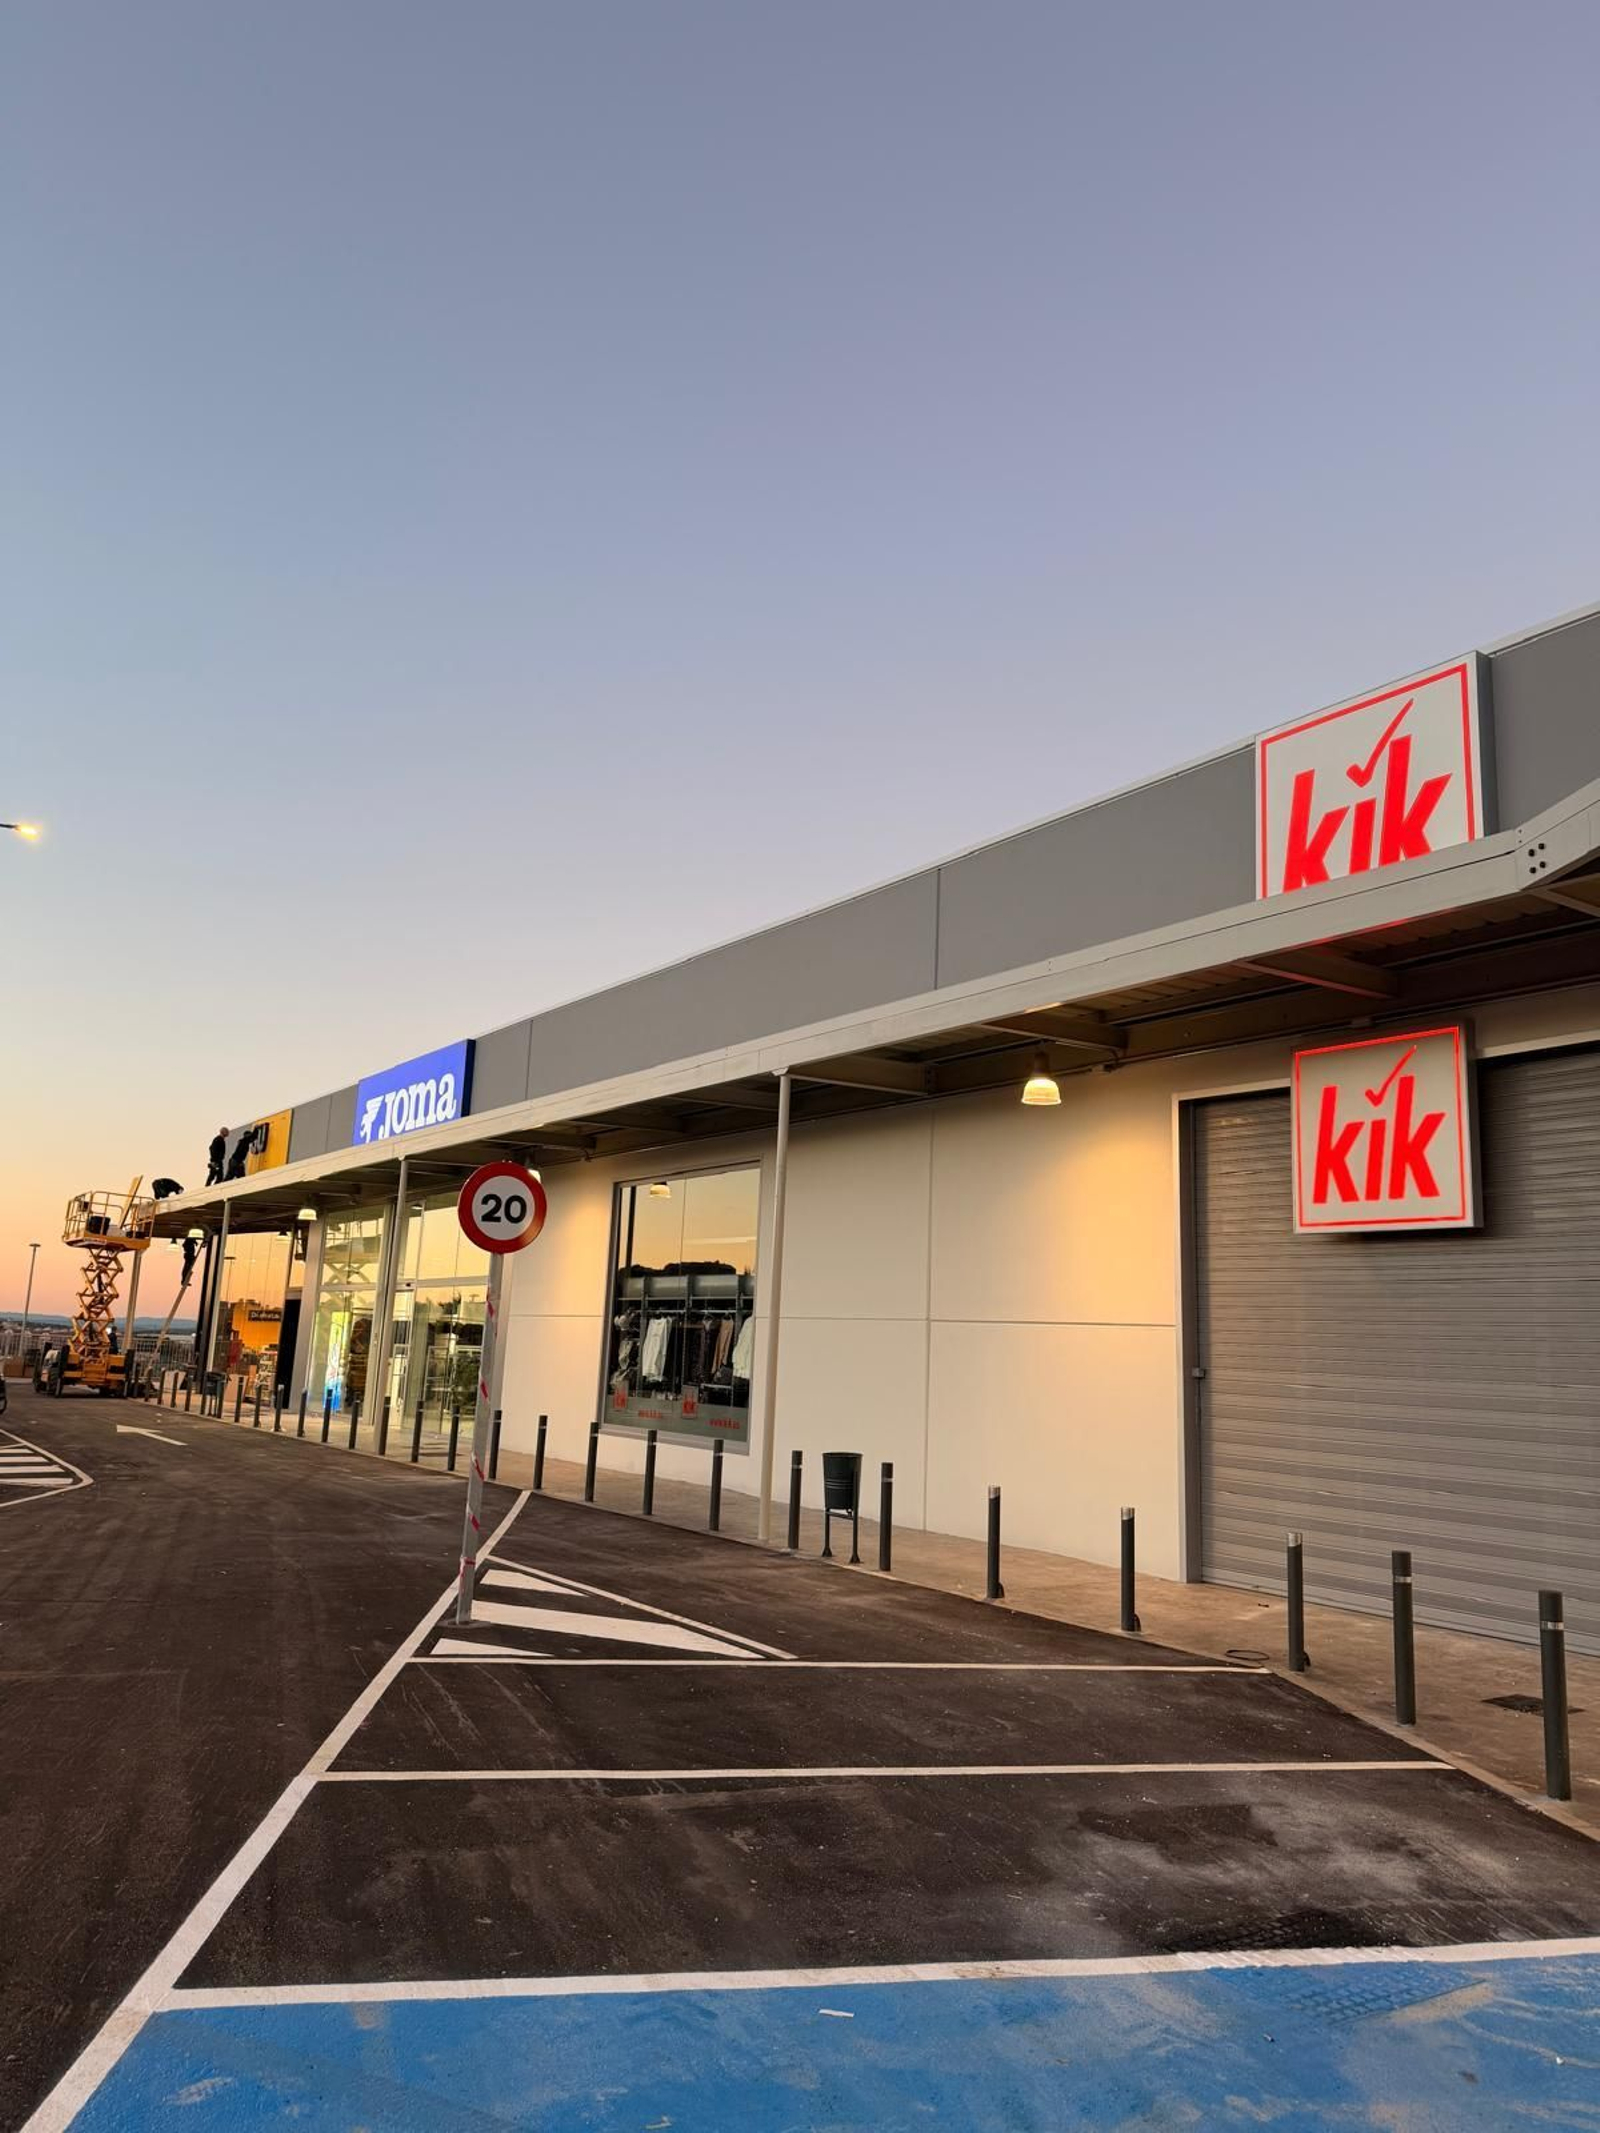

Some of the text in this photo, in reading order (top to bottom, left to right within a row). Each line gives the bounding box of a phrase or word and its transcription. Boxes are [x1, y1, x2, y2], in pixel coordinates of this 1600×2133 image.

[1283, 699, 1452, 893] kik
[1313, 1046, 1445, 1204] kik
[481, 1193, 527, 1224] 20
